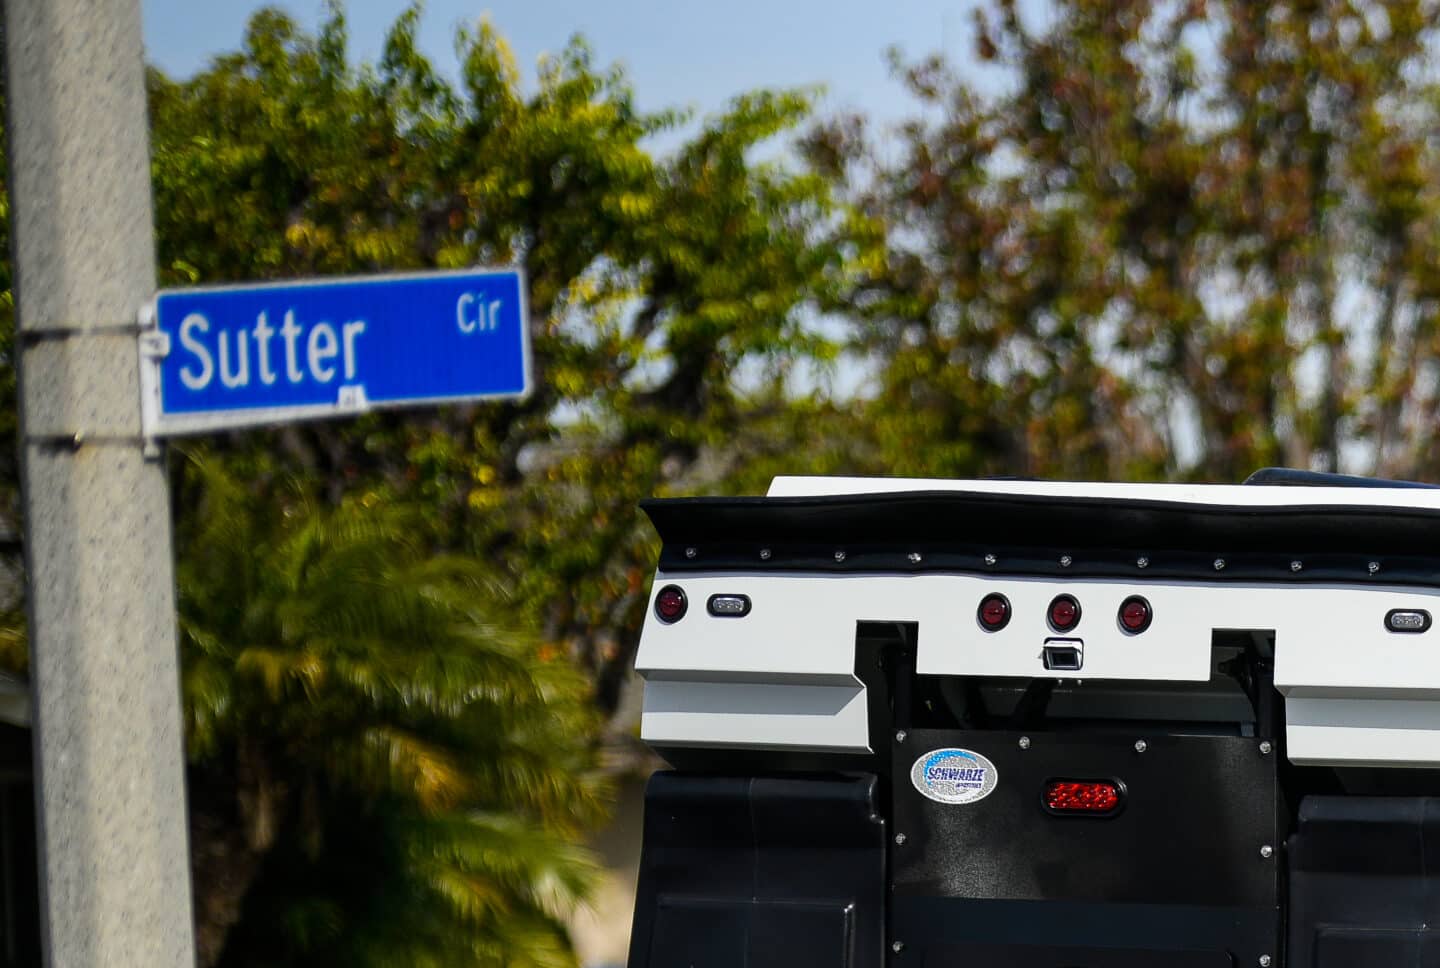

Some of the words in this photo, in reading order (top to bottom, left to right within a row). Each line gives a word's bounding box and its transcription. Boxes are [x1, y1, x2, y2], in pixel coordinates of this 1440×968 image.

[178, 309, 367, 390] Sutter
[456, 292, 502, 334] Cir
[927, 766, 986, 782] SCHWARZE
